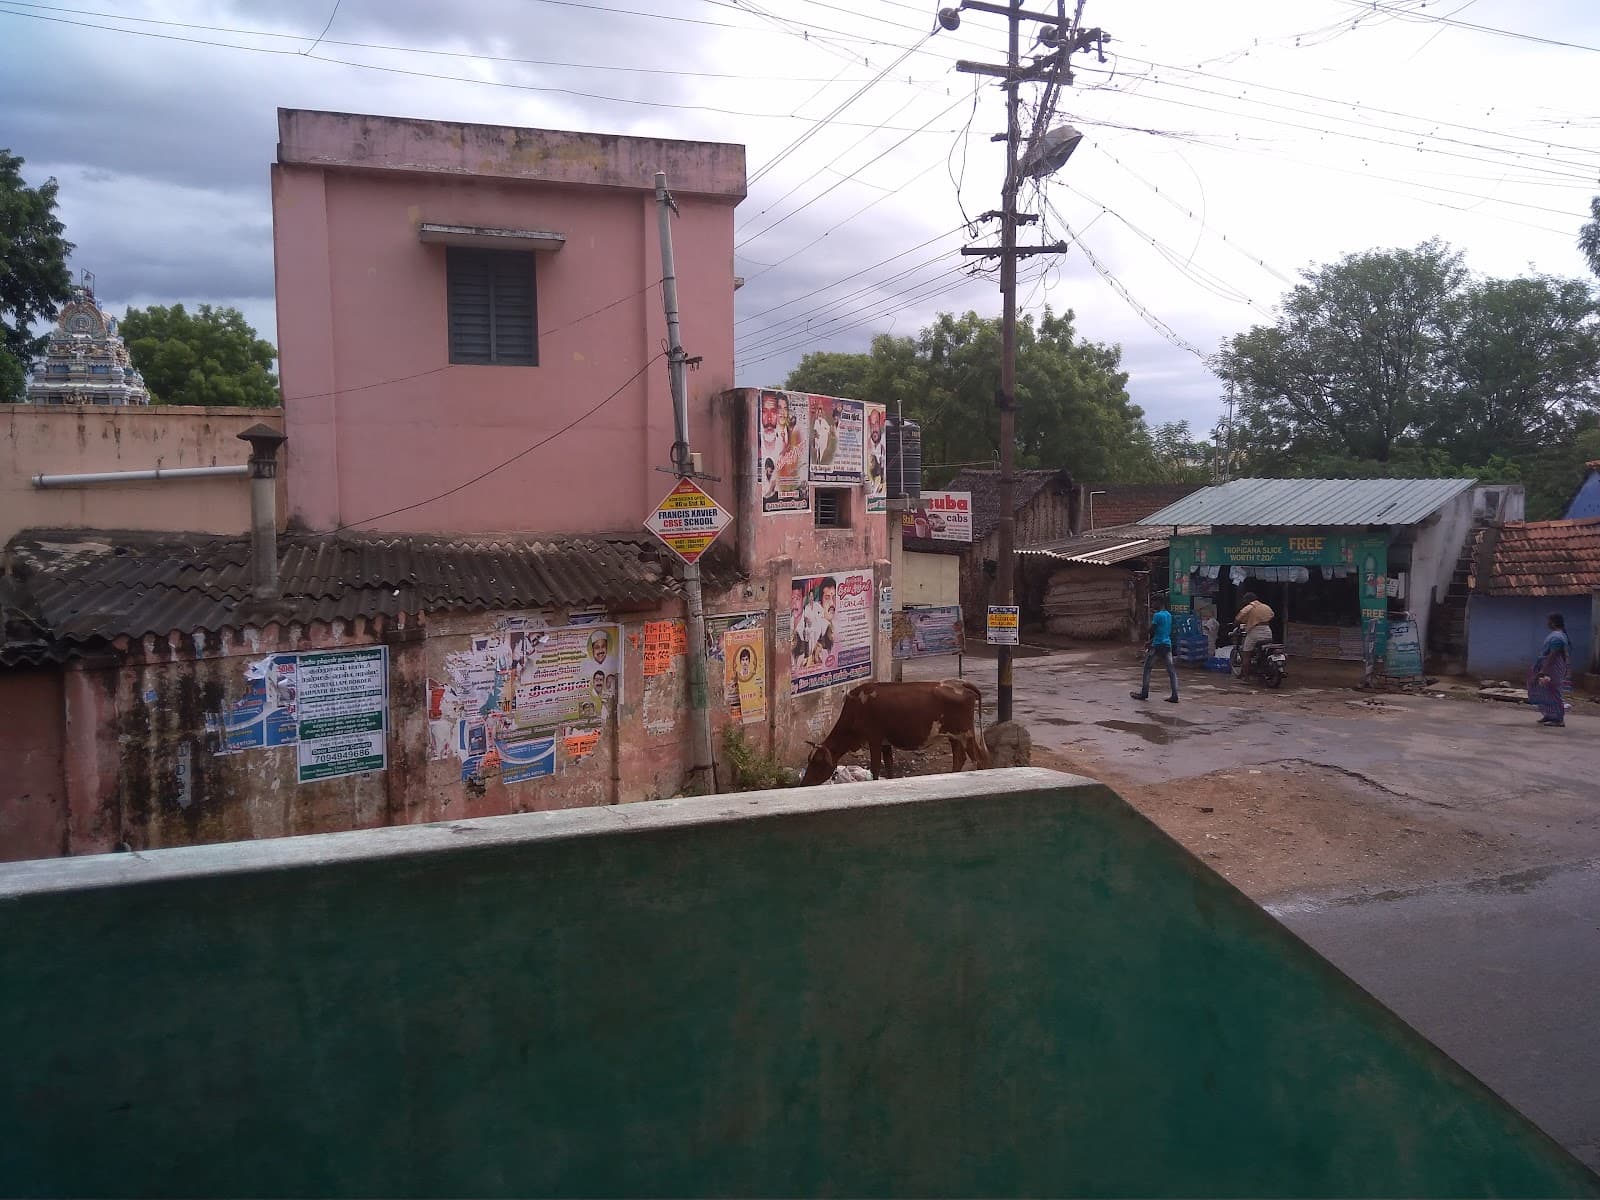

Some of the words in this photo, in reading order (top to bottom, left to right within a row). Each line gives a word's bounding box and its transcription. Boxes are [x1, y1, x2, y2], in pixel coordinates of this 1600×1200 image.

[658, 510, 690, 519] FRANCIS
[691, 508, 718, 518] XAVIER
[946, 514, 968, 522] cabs
[663, 519, 682, 528] CBSE
[684, 518, 714, 526] SCHOOL
[1362, 608, 1384, 618] FREE
